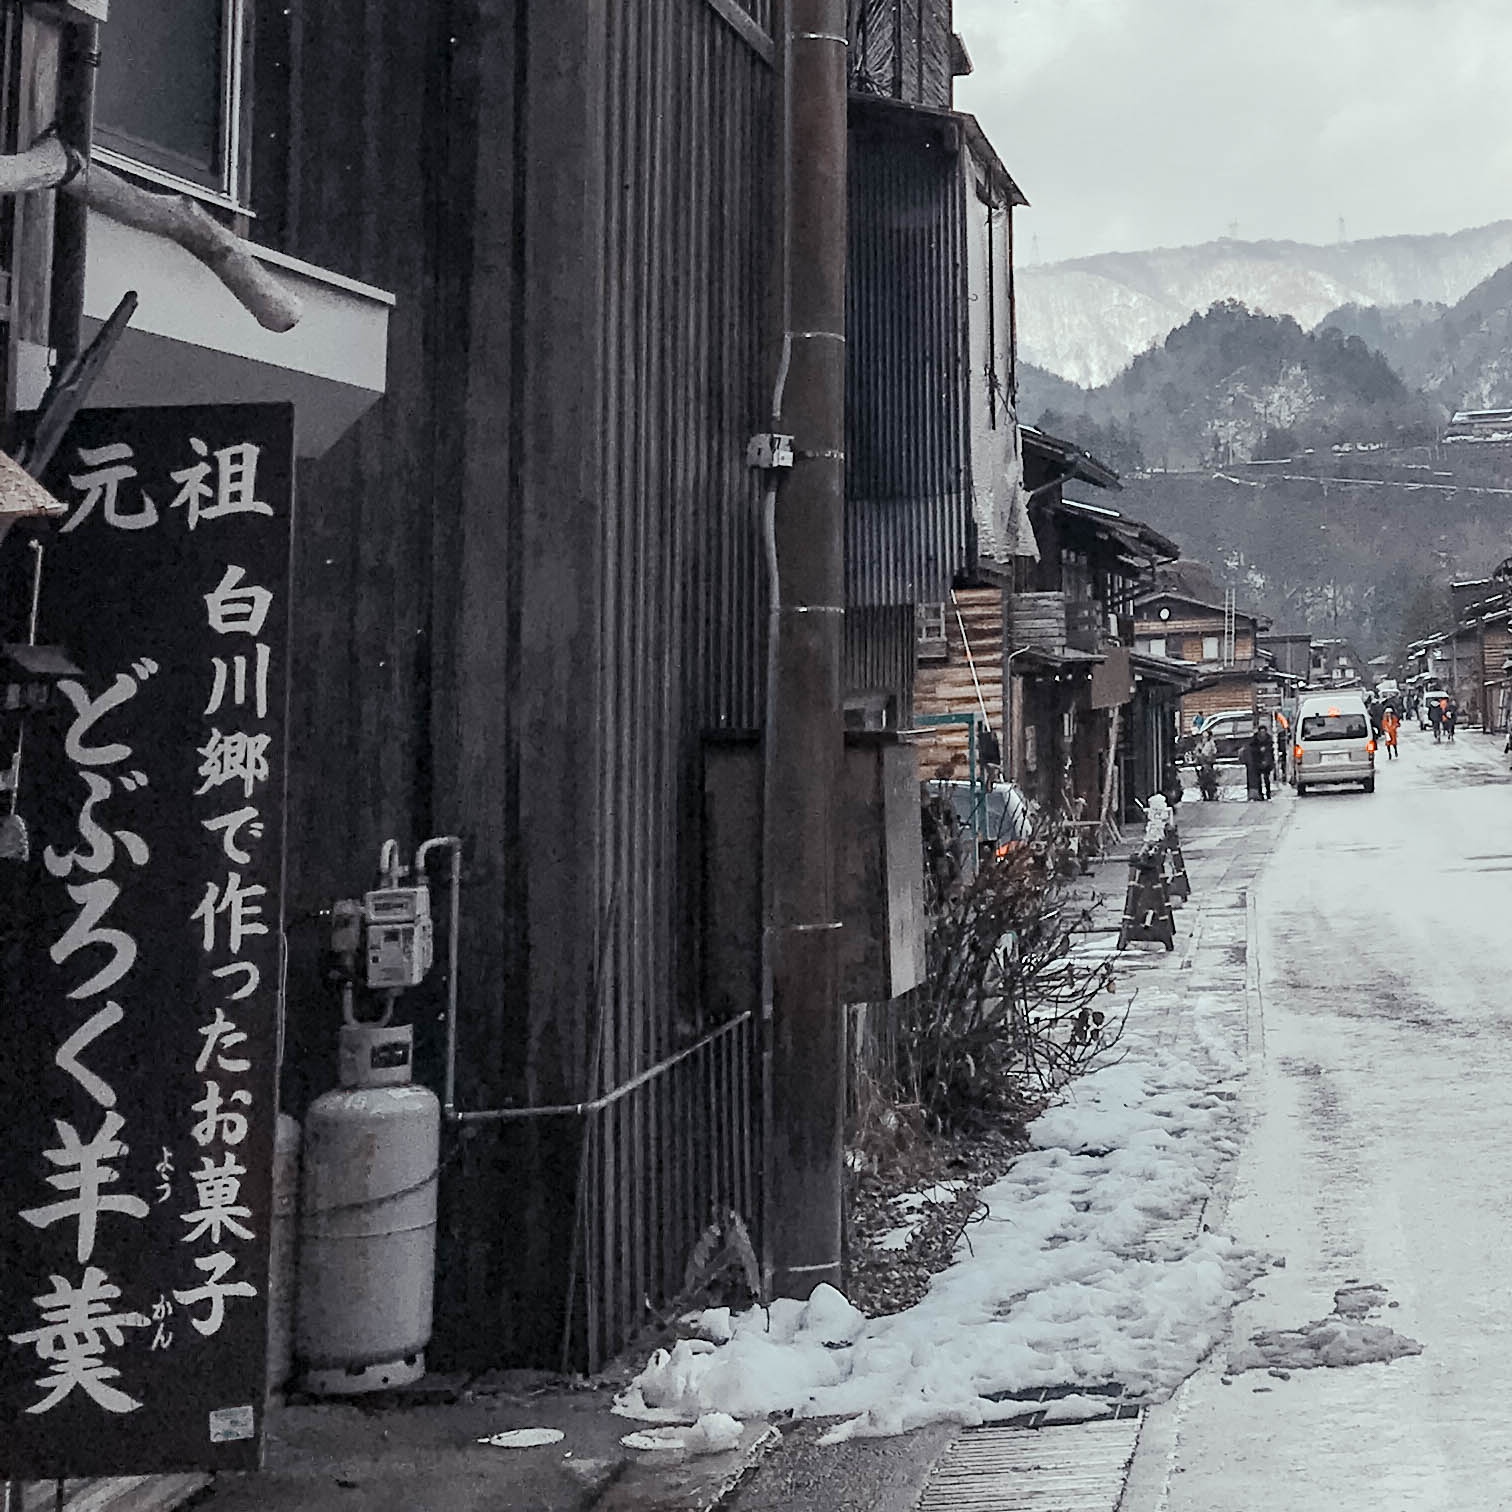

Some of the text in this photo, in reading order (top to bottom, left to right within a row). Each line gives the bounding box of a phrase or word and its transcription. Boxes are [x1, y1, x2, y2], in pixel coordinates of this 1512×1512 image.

[59, 438, 274, 532] 元祖
[8, 656, 159, 1414] どぶろく羊羹
[173, 564, 274, 1336] 白川郷で作ったお菓子
[151, 1293, 174, 1352] かん
